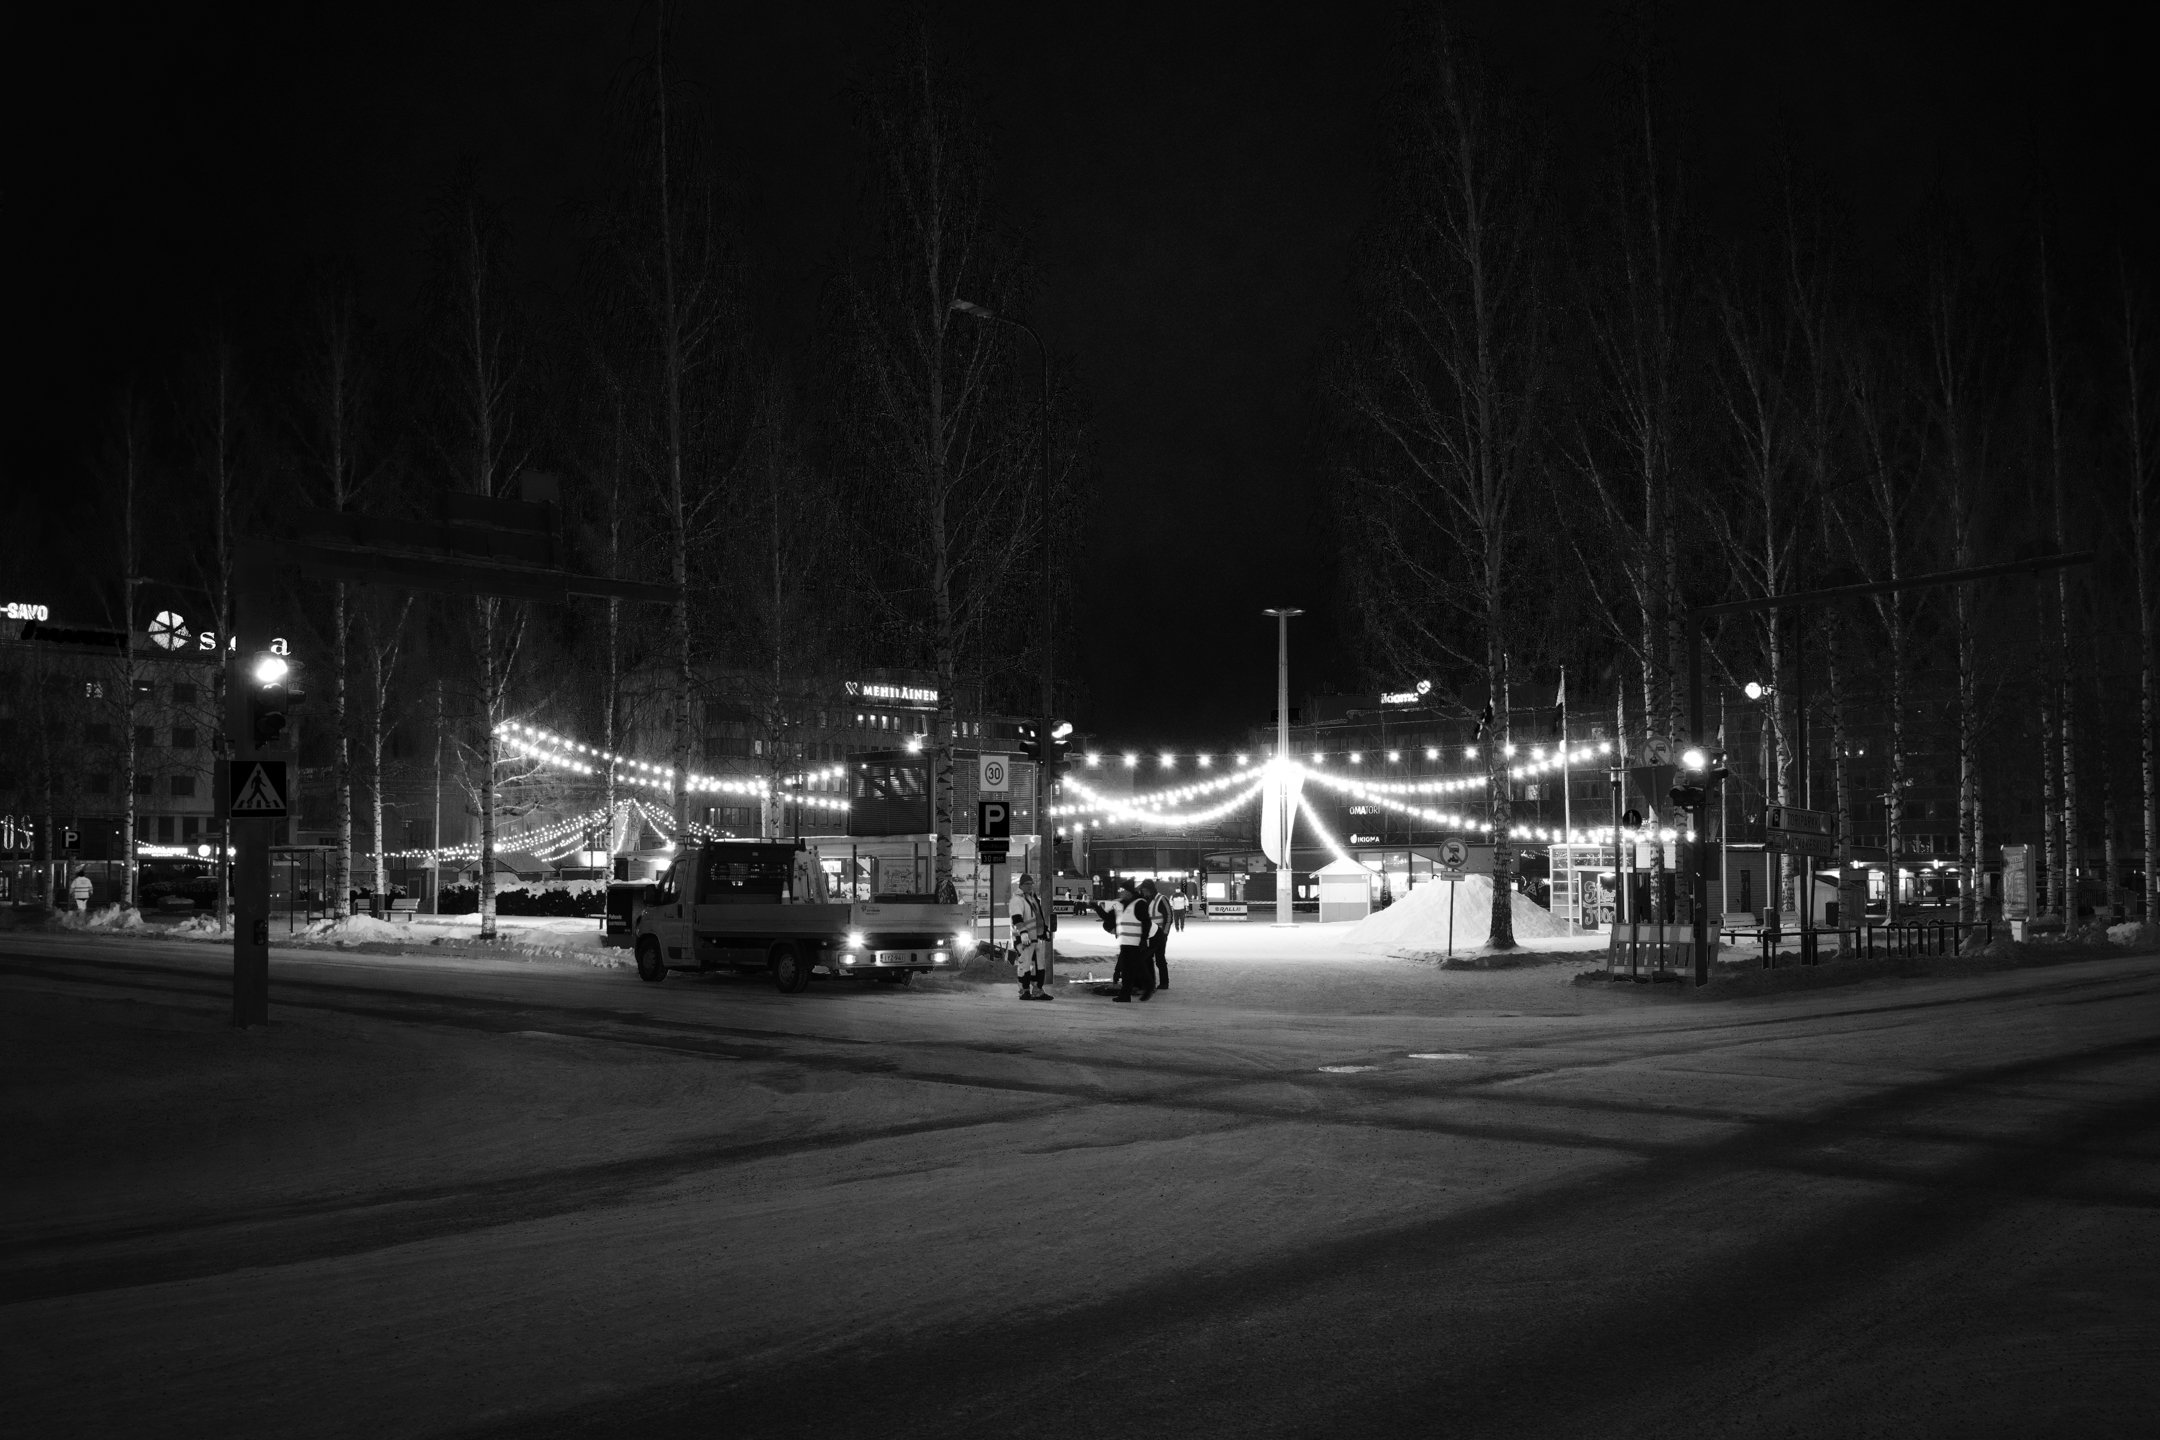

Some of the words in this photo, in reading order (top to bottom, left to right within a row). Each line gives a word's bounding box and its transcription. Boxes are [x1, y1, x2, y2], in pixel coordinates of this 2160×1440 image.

[863, 685, 938, 701] MEHILÄINEN
[988, 767, 1001, 780] 30
[1349, 805, 1380, 815] OMATORI
[985, 804, 1006, 835] P
[65, 832, 78, 848] P
[983, 855, 991, 863] 30
